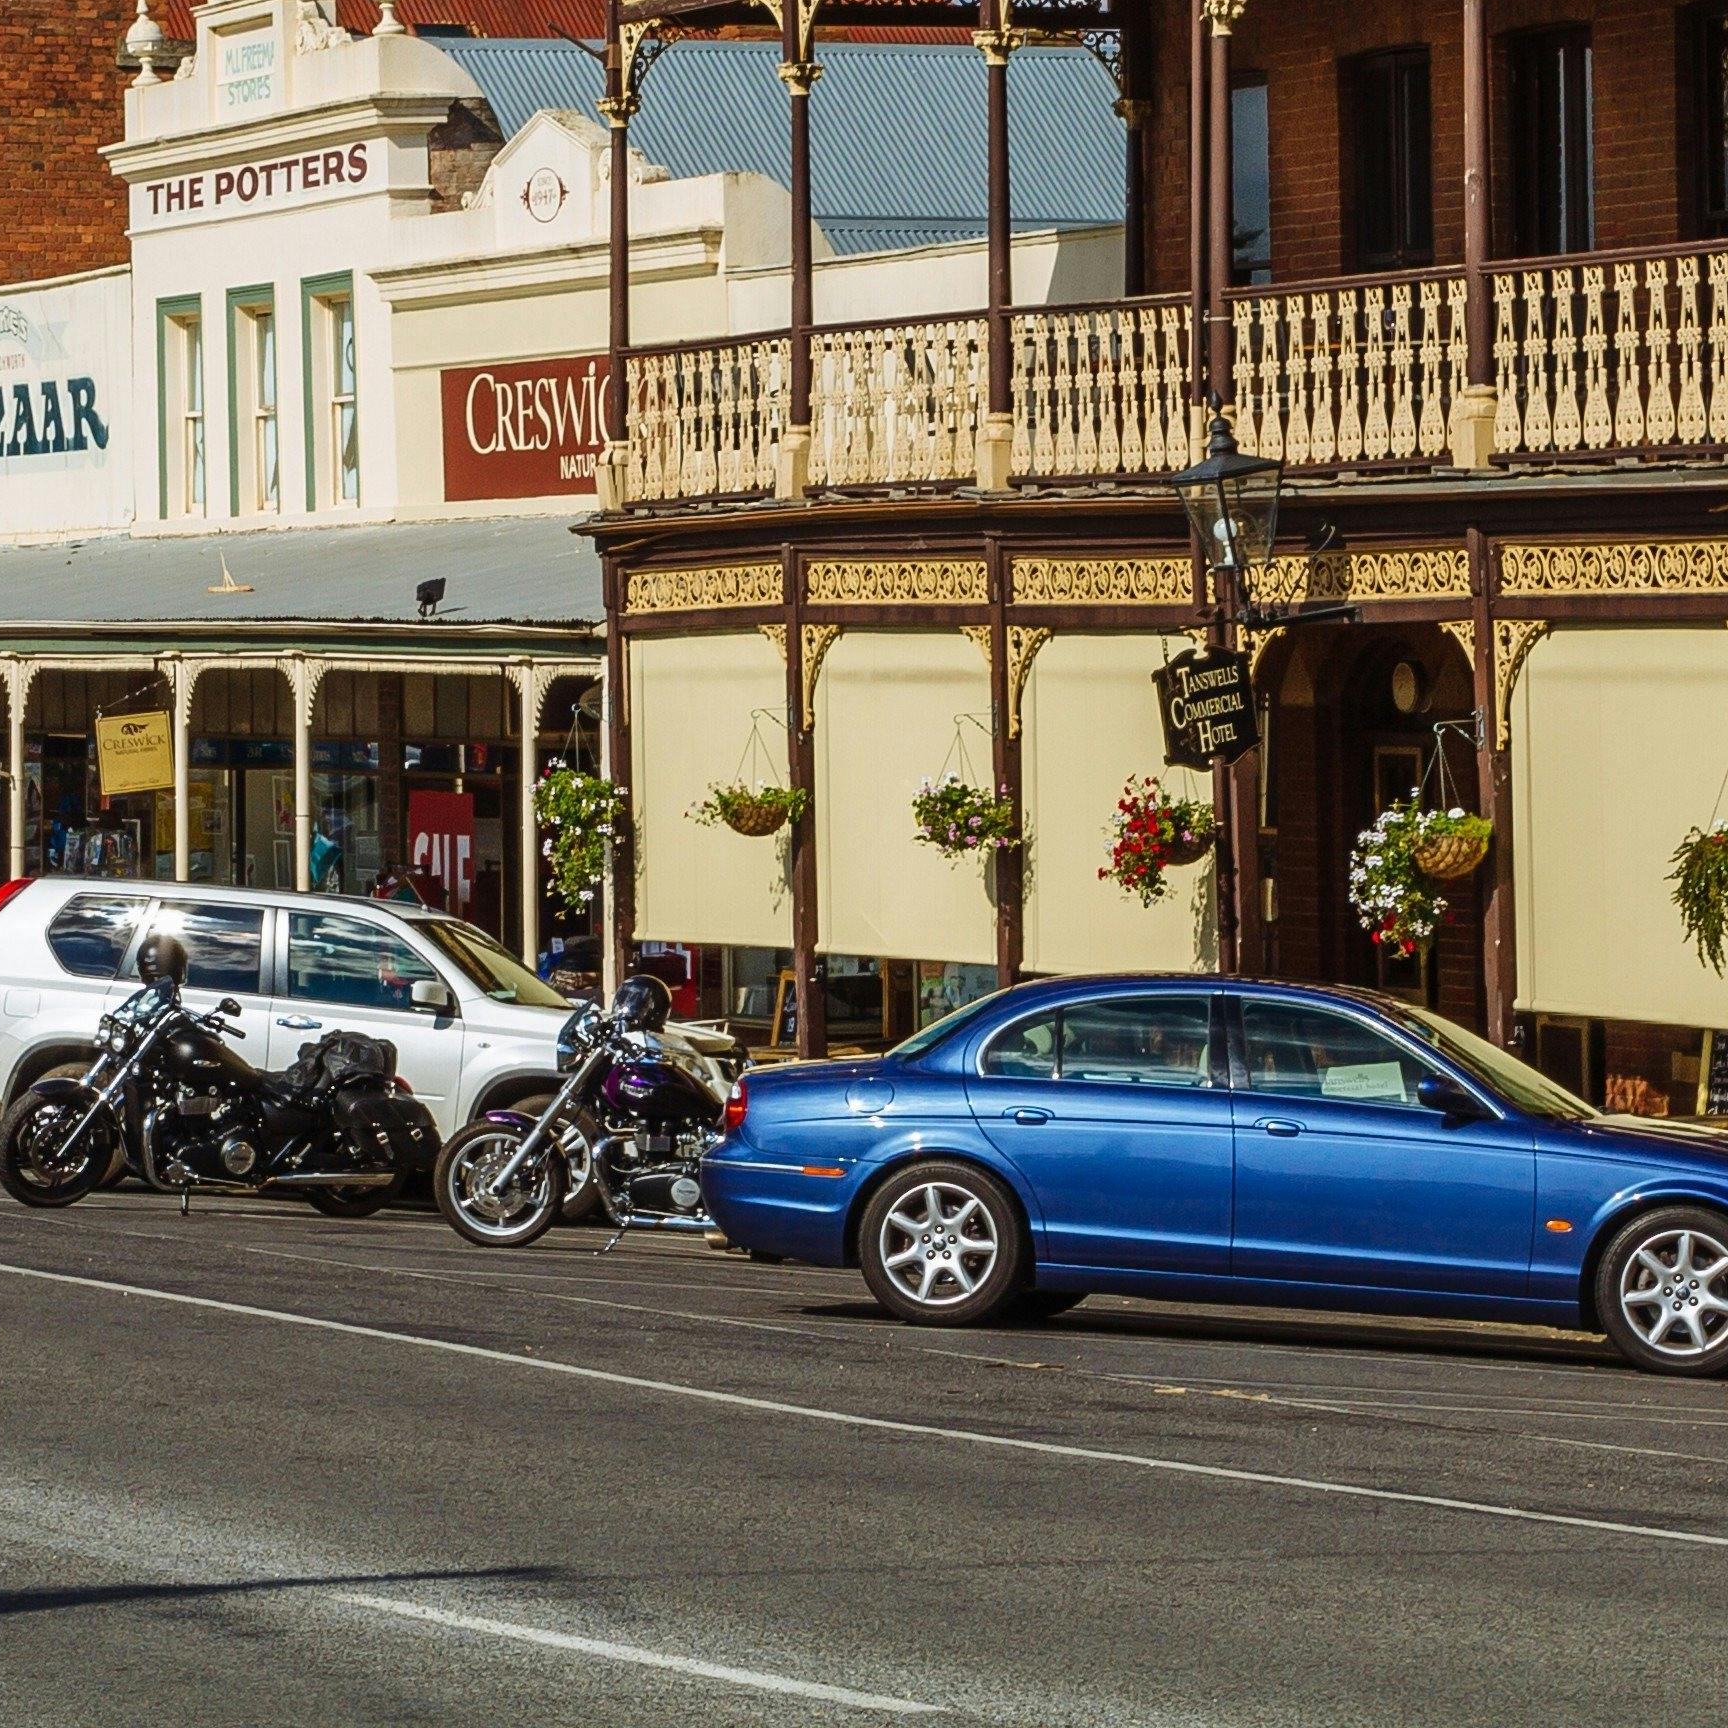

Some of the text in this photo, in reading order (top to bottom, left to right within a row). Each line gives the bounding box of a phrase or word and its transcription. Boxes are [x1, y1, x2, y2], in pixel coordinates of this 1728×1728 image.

[228, 75, 271, 105] STORES
[147, 143, 367, 214] THE POTTERS
[466, 361, 610, 454] CRESWIC
[560, 453, 597, 479] NATUR
[1177, 666, 1239, 698] TANSWELLS
[1171, 693, 1244, 730] COMMERCIAL
[103, 734, 165, 751] CRESWICK
[1197, 720, 1237, 753] HOTEL
